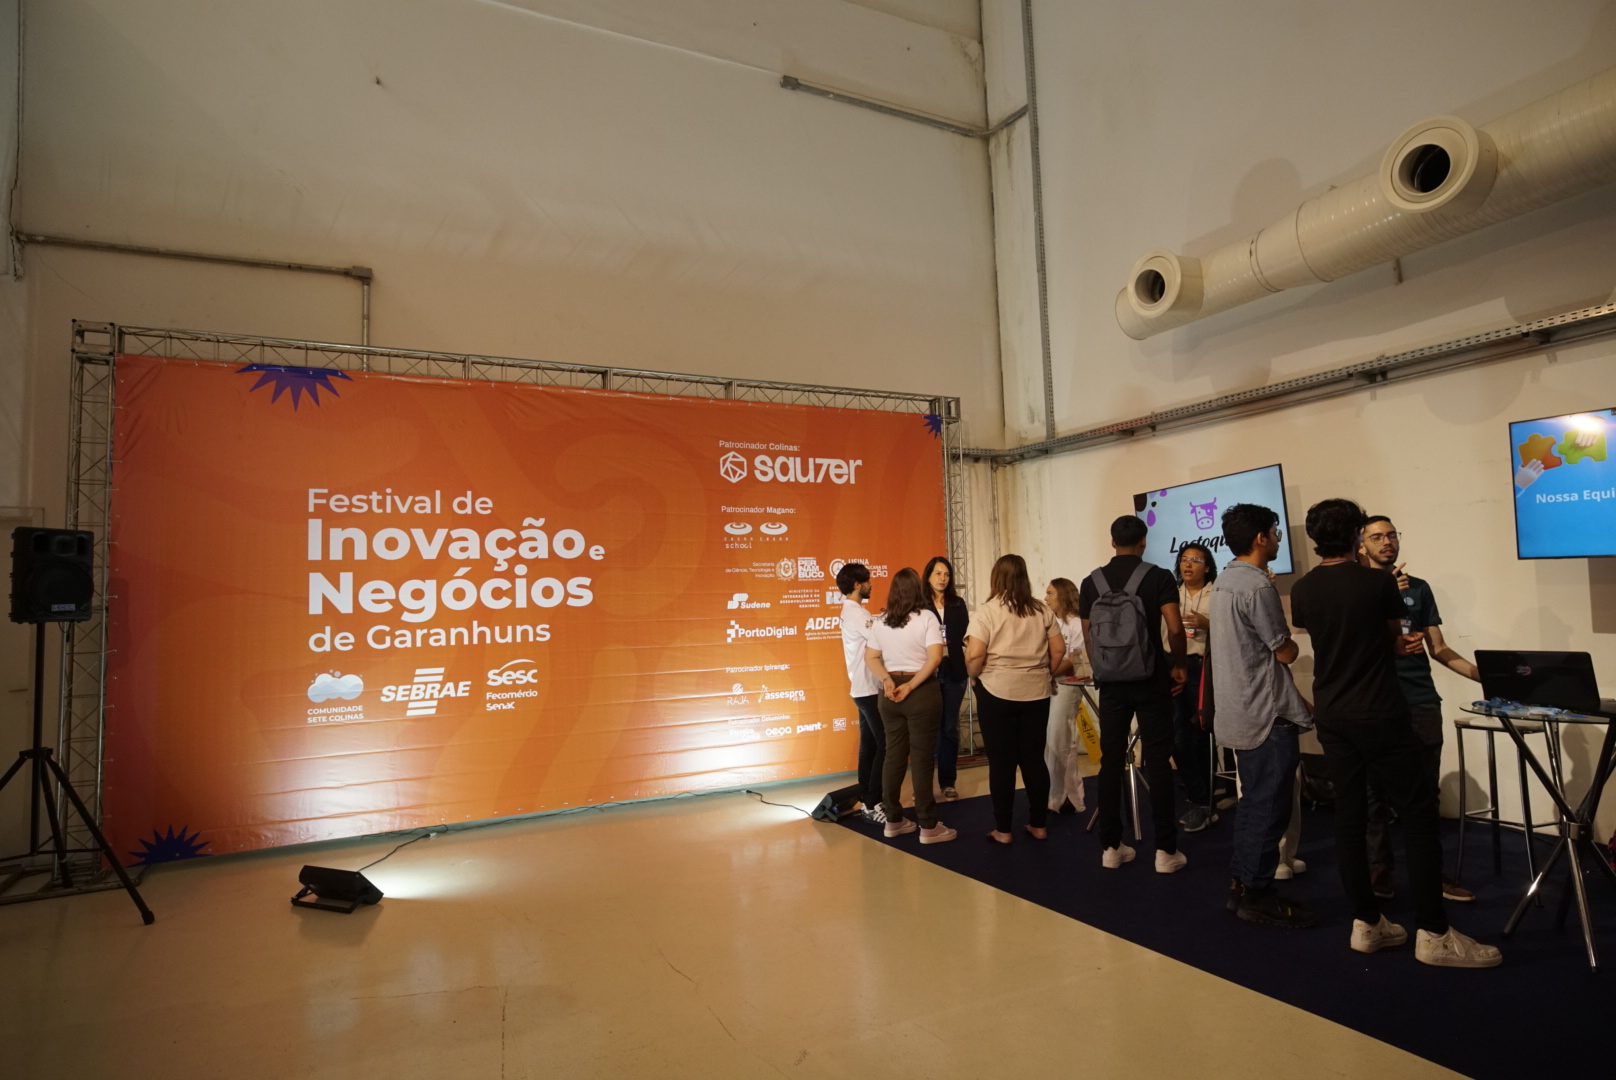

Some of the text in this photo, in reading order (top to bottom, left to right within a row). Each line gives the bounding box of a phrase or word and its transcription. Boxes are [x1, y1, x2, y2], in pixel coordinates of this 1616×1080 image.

[719, 440, 800, 452] Patrocinador Colinas:
[308, 488, 494, 515] Festival de
[1536, 487, 1616, 504] Nossa Equi
[721, 505, 797, 515] Patrocinador Magano:
[307, 517, 605, 572] Inovação e
[308, 564, 594, 623] Negócios
[740, 601, 771, 609] Sudene
[308, 620, 551, 652] de Garanhuns
[738, 625, 797, 639] PortoDigital
[486, 662, 538, 686] Sesc
[726, 665, 763, 673] Patrocinador
[380, 680, 471, 703] SEBRAE
[486, 689, 538, 700] Fecomércio
[765, 690, 804, 700] assespro
[307, 705, 363, 715] COMUNIDADE
[486, 701, 515, 711] Senac
[328, 713, 364, 722] COLINAS
[797, 721, 821, 734] paint
